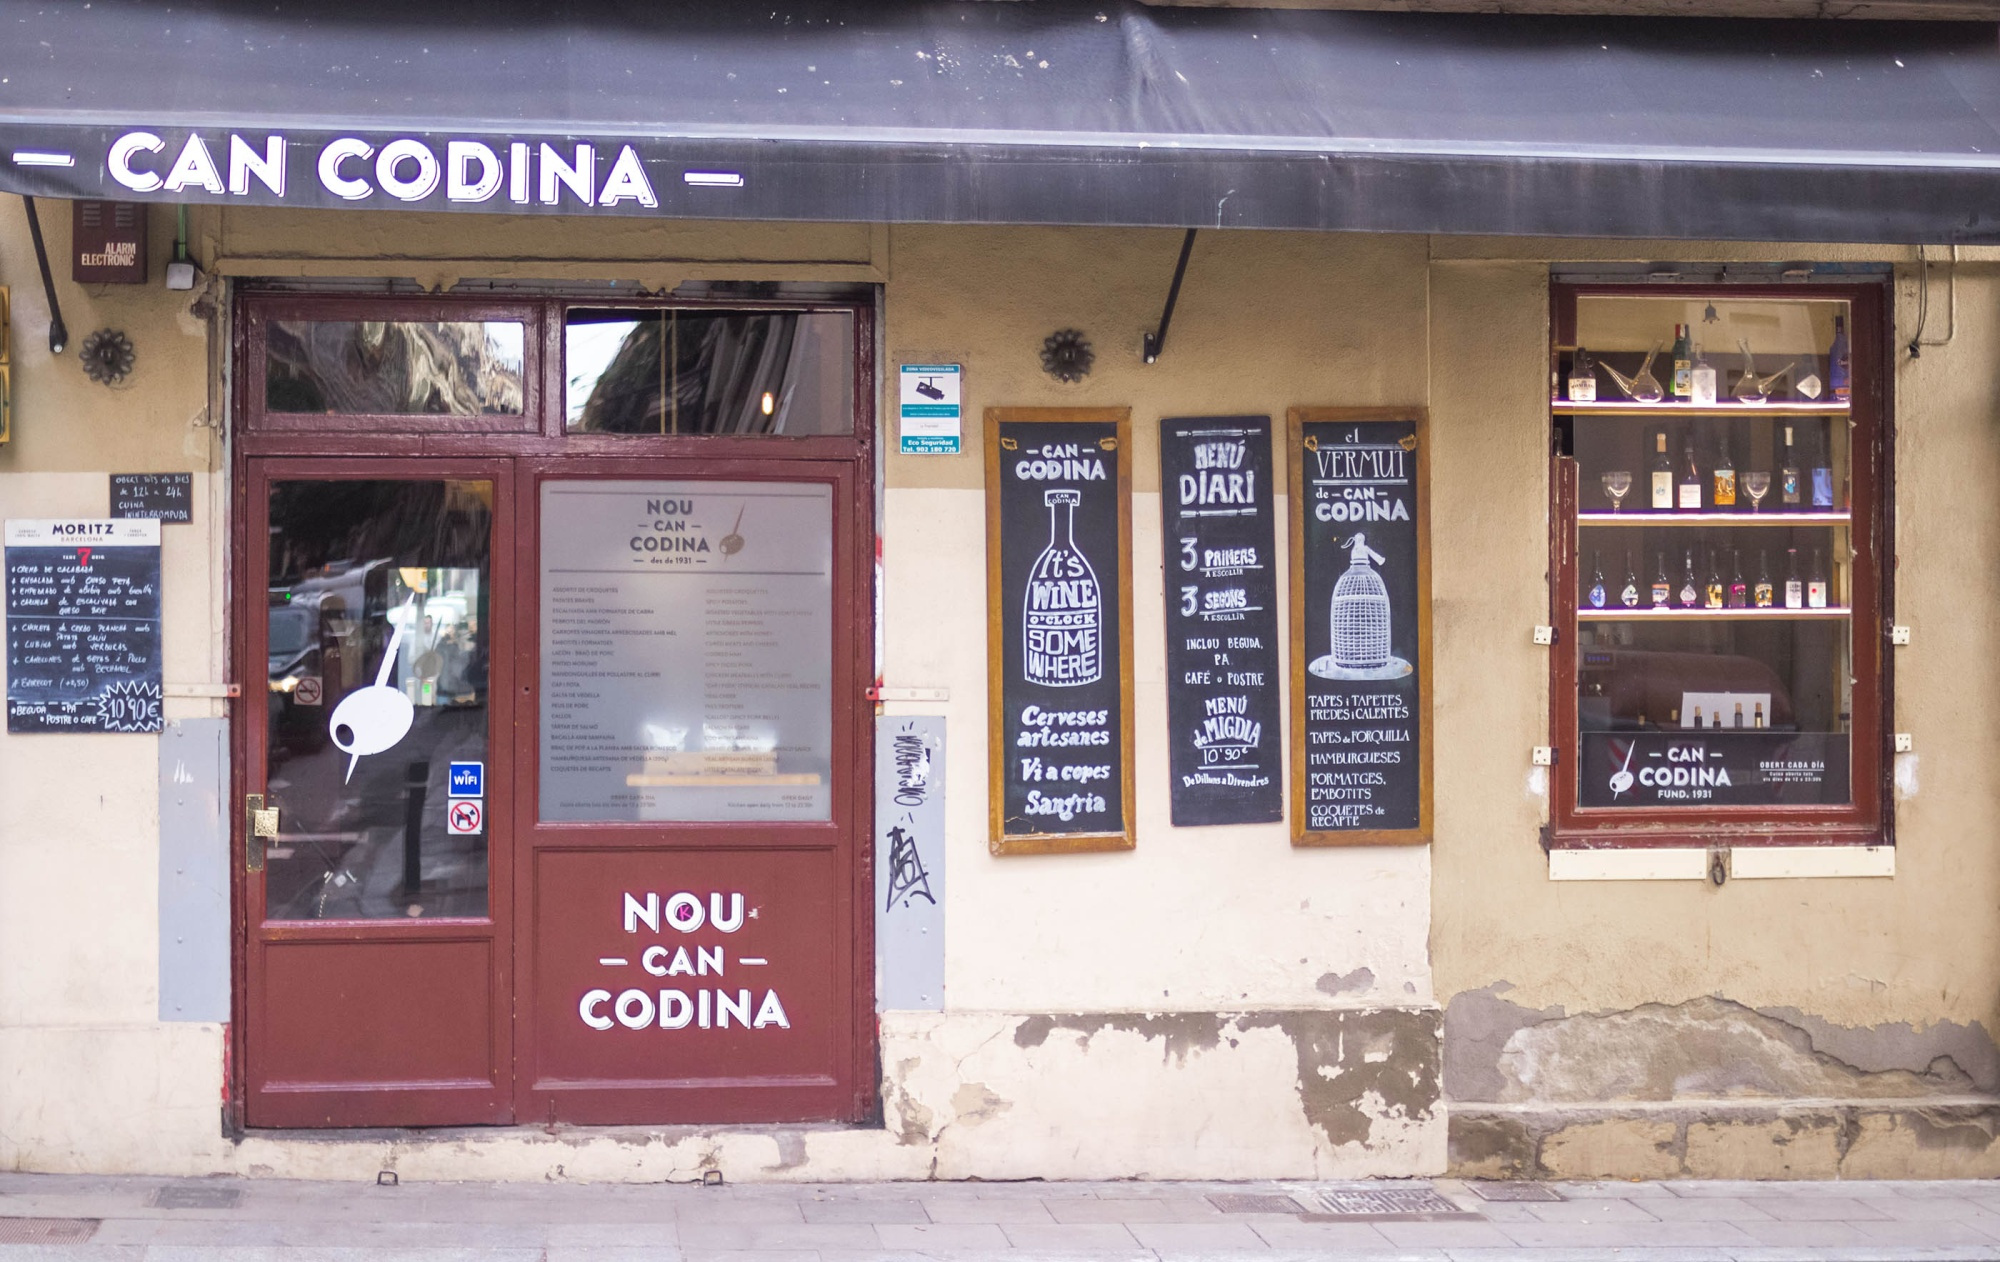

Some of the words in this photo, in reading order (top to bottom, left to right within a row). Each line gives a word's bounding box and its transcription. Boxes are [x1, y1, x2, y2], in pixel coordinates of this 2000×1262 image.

[106, 131, 287, 199] CAN
[317, 136, 659, 208] CODINA
[105, 242, 136, 254] ALARM
[82, 254, 134, 266] ELECTRONIC
[1345, 428, 1360, 443] el
[1042, 444, 1078, 458] CAN
[1194, 439, 1246, 470] MENÚ
[1016, 460, 1106, 480] CODINA
[1316, 450, 1408, 478] VERMUT
[1180, 470, 1255, 506] DIARI
[1316, 487, 1329, 499] de
[1344, 487, 1375, 500] CAN
[647, 500, 693, 515] NOU
[1315, 498, 1410, 522] CODINA
[52, 524, 114, 535] MORITZ
[654, 520, 685, 532] CAN
[630, 536, 711, 552] CODINA
[77, 548, 92, 566] 7
[1180, 537, 1198, 572] 3
[1204, 547, 1257, 567] PRIMERS
[1038, 549, 1084, 578] It's
[1032, 579, 1097, 611] WINE
[1181, 586, 1198, 617] 3
[1204, 589, 1246, 610] SEGONS
[1030, 613, 1096, 625] O'CLOCK
[1028, 628, 1096, 656] SOME
[1186, 638, 1220, 650] INCLOU
[1028, 650, 1096, 679] WHERE
[1185, 670, 1210, 685] CAFÉ
[1227, 672, 1264, 686] POSTRE
[1205, 696, 1248, 716] MENÚ
[1308, 695, 1342, 707] TAPES
[1351, 694, 1402, 706] TAPETES
[17, 706, 46, 716] BEGUDA
[1022, 705, 1108, 726] Cerveses
[1310, 709, 1350, 720] FREDES
[1355, 707, 1409, 720] CALENTES
[46, 716, 71, 725] POSTRE
[1017, 726, 1110, 747] artesanes
[1203, 716, 1262, 748] MIGDIA
[1310, 732, 1342, 744] TAPES
[1351, 730, 1410, 745] FORQUILLA
[1310, 751, 1400, 765] HAMBURGUESES
[1667, 747, 1704, 762] CAN
[1020, 757, 1042, 782] Vi
[1046, 766, 1058, 781] a
[1061, 765, 1111, 784] copes
[1811, 760, 1825, 768] DÍA
[1227, 774, 1269, 787] Divendres
[1639, 767, 1732, 787] CODINA
[1311, 788, 1371, 801] EMBOTITS
[1657, 789, 1690, 799] FUND.
[1692, 789, 1712, 799] 1931
[1024, 790, 1106, 821] Sangria
[1310, 804, 1374, 817] COQUETES
[1375, 807, 1385, 815] de
[1311, 816, 1360, 828] RECAPTE
[624, 892, 744, 933] NOU
[642, 946, 724, 976] CAN
[579, 988, 790, 1031] CODINA
